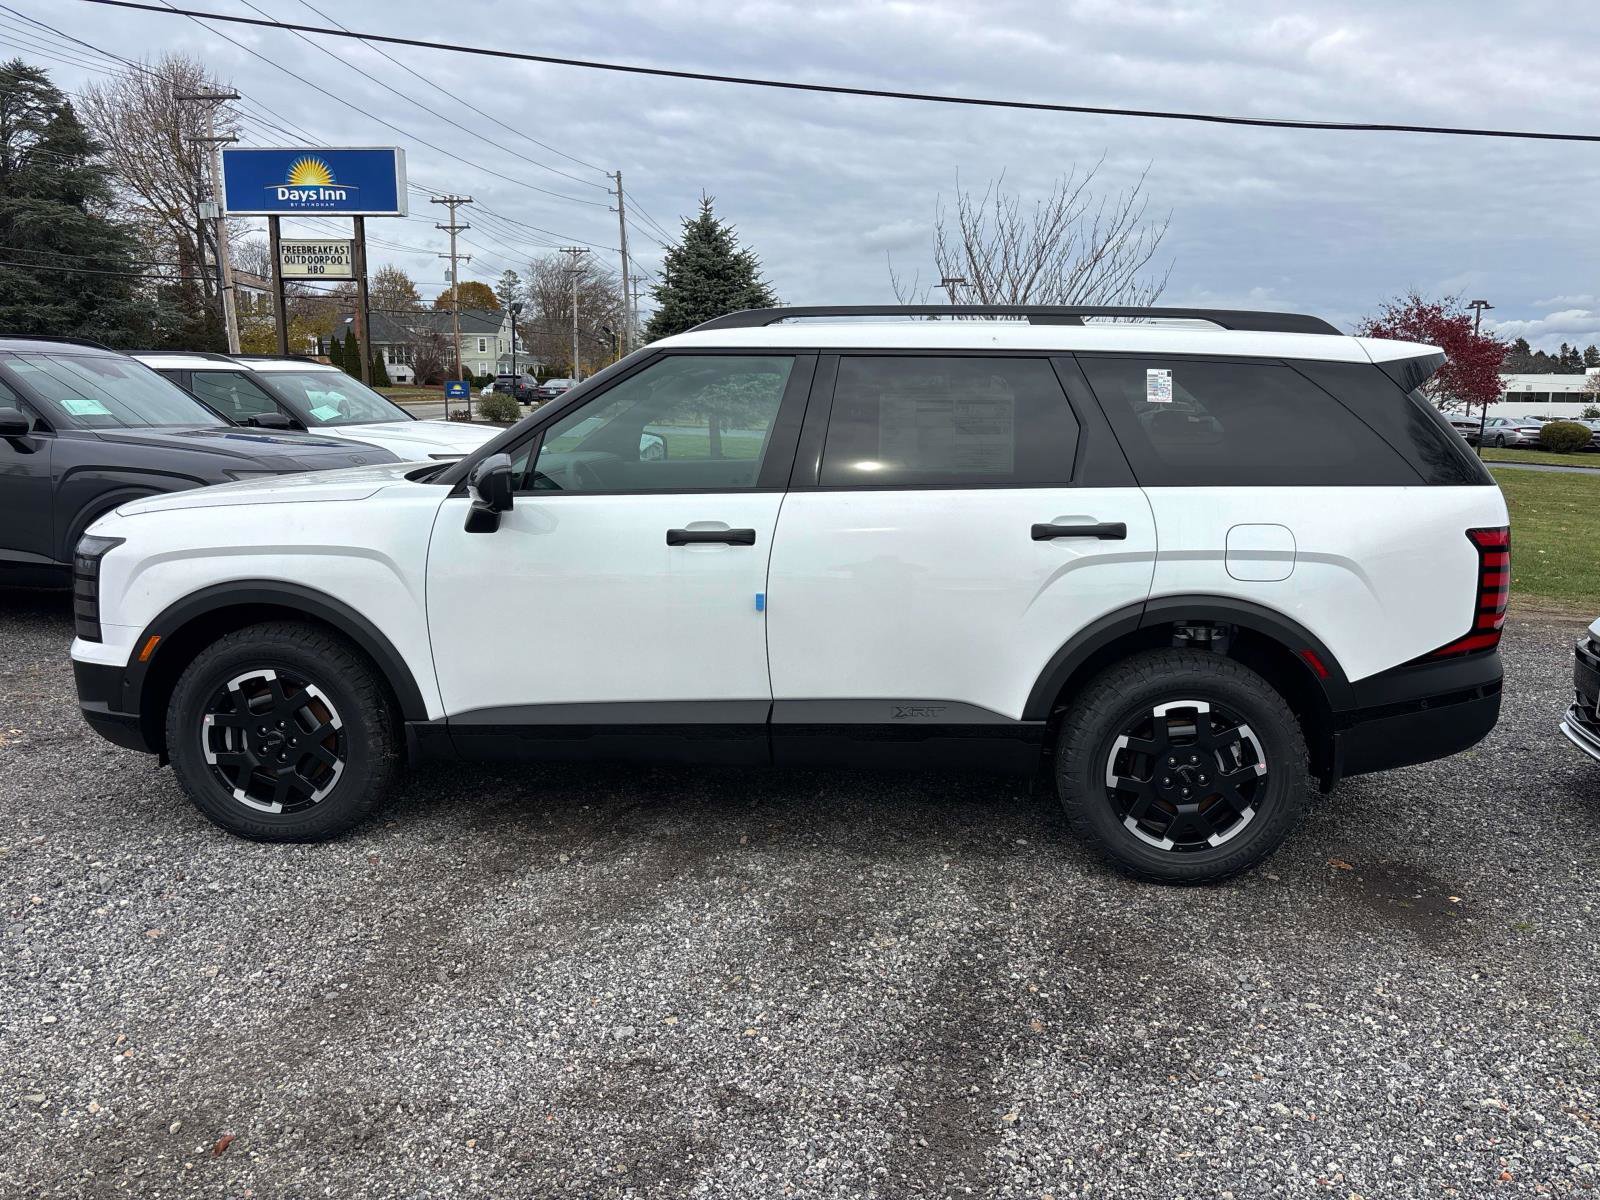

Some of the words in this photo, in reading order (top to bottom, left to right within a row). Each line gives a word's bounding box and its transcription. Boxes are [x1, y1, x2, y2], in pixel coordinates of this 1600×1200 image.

[277, 187, 317, 202] Days
[319, 187, 347, 201] Inn
[307, 265, 325, 274] HBO
[895, 706, 947, 718] XRT
